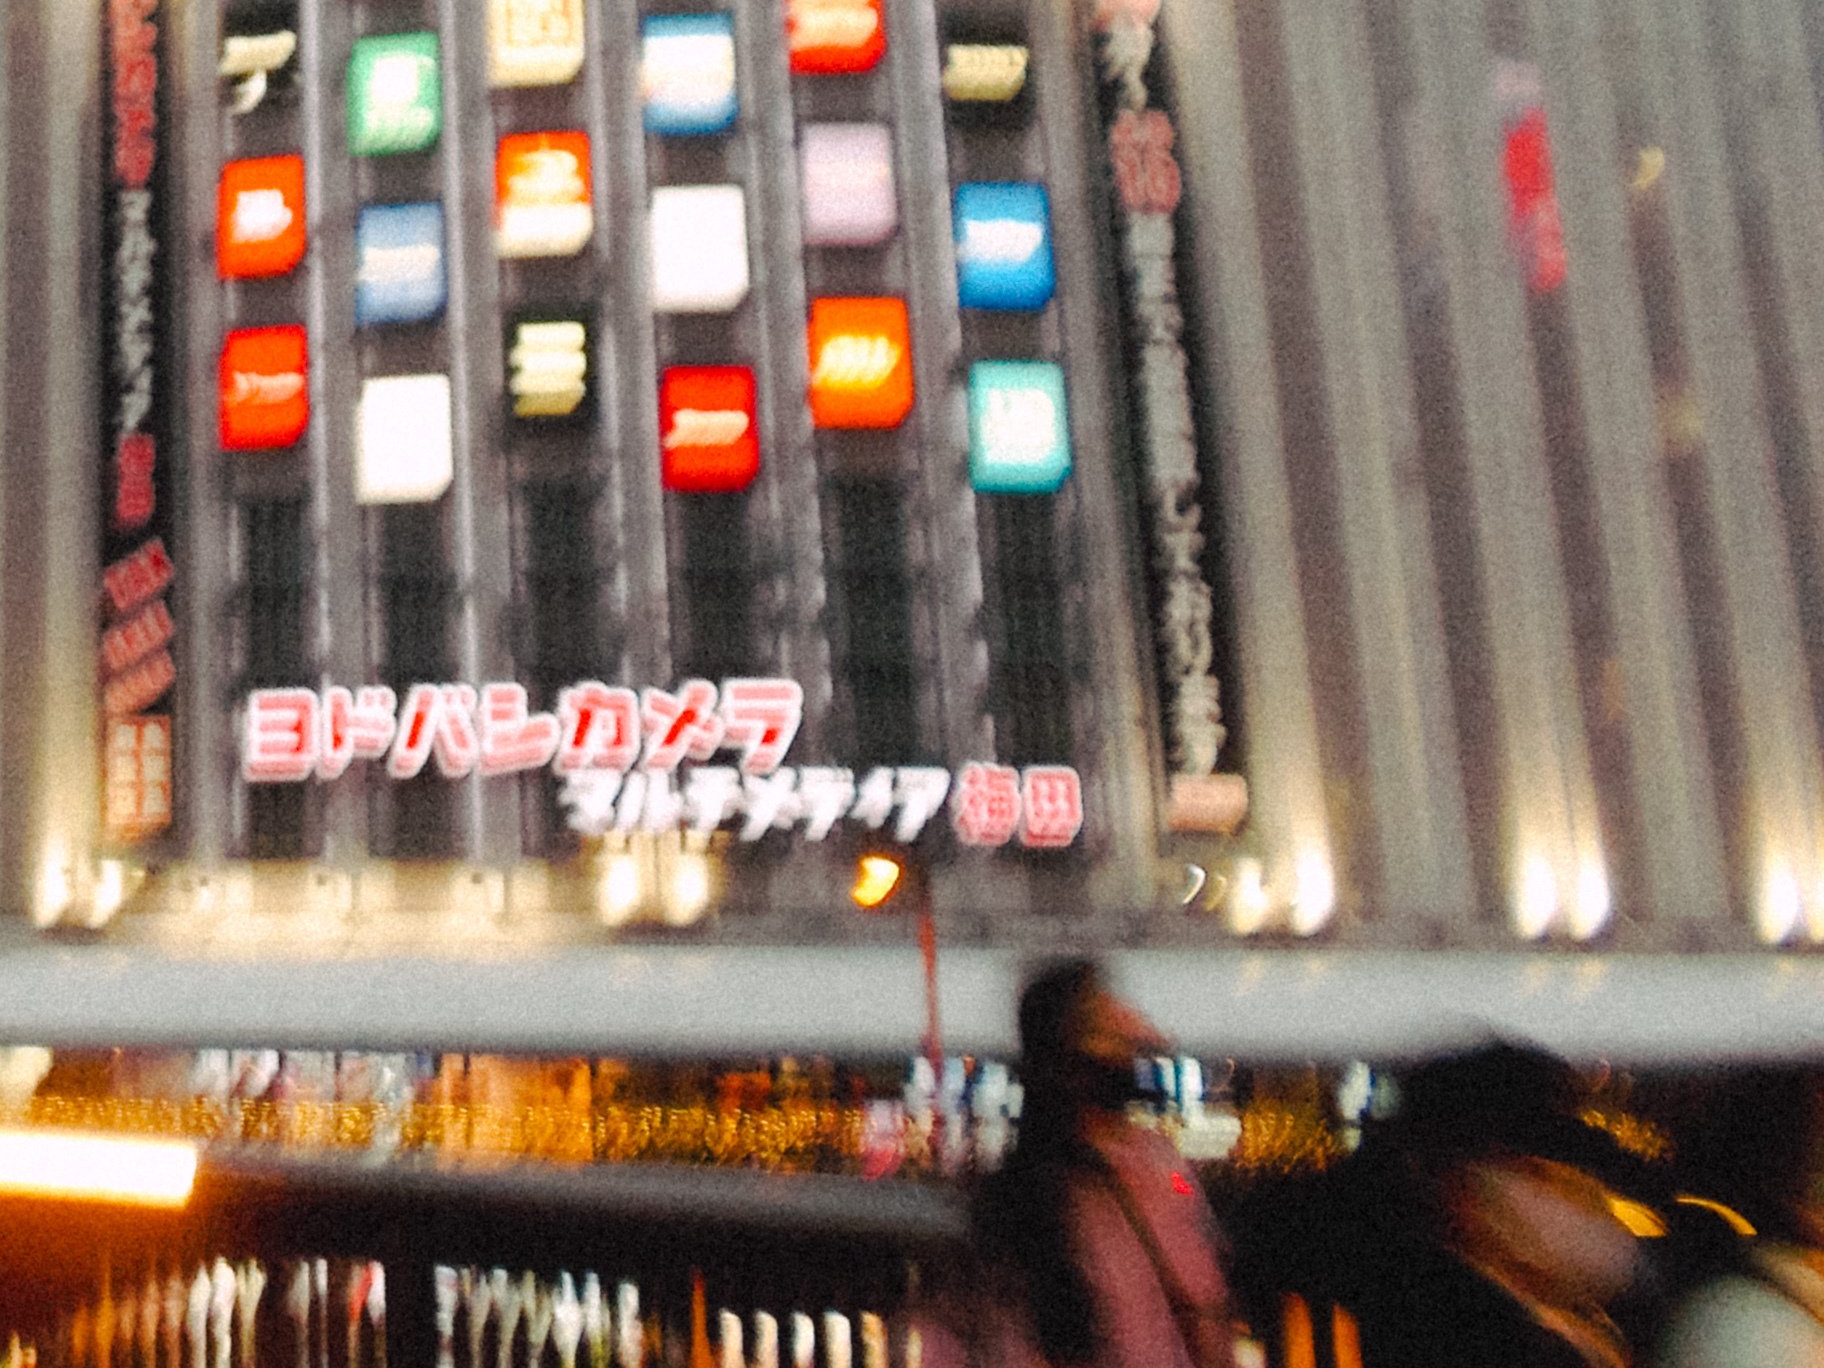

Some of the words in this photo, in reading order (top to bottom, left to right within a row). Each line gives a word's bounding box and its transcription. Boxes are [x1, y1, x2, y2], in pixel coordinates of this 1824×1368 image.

[243, 679, 804, 781] ヨドバシカメラ
